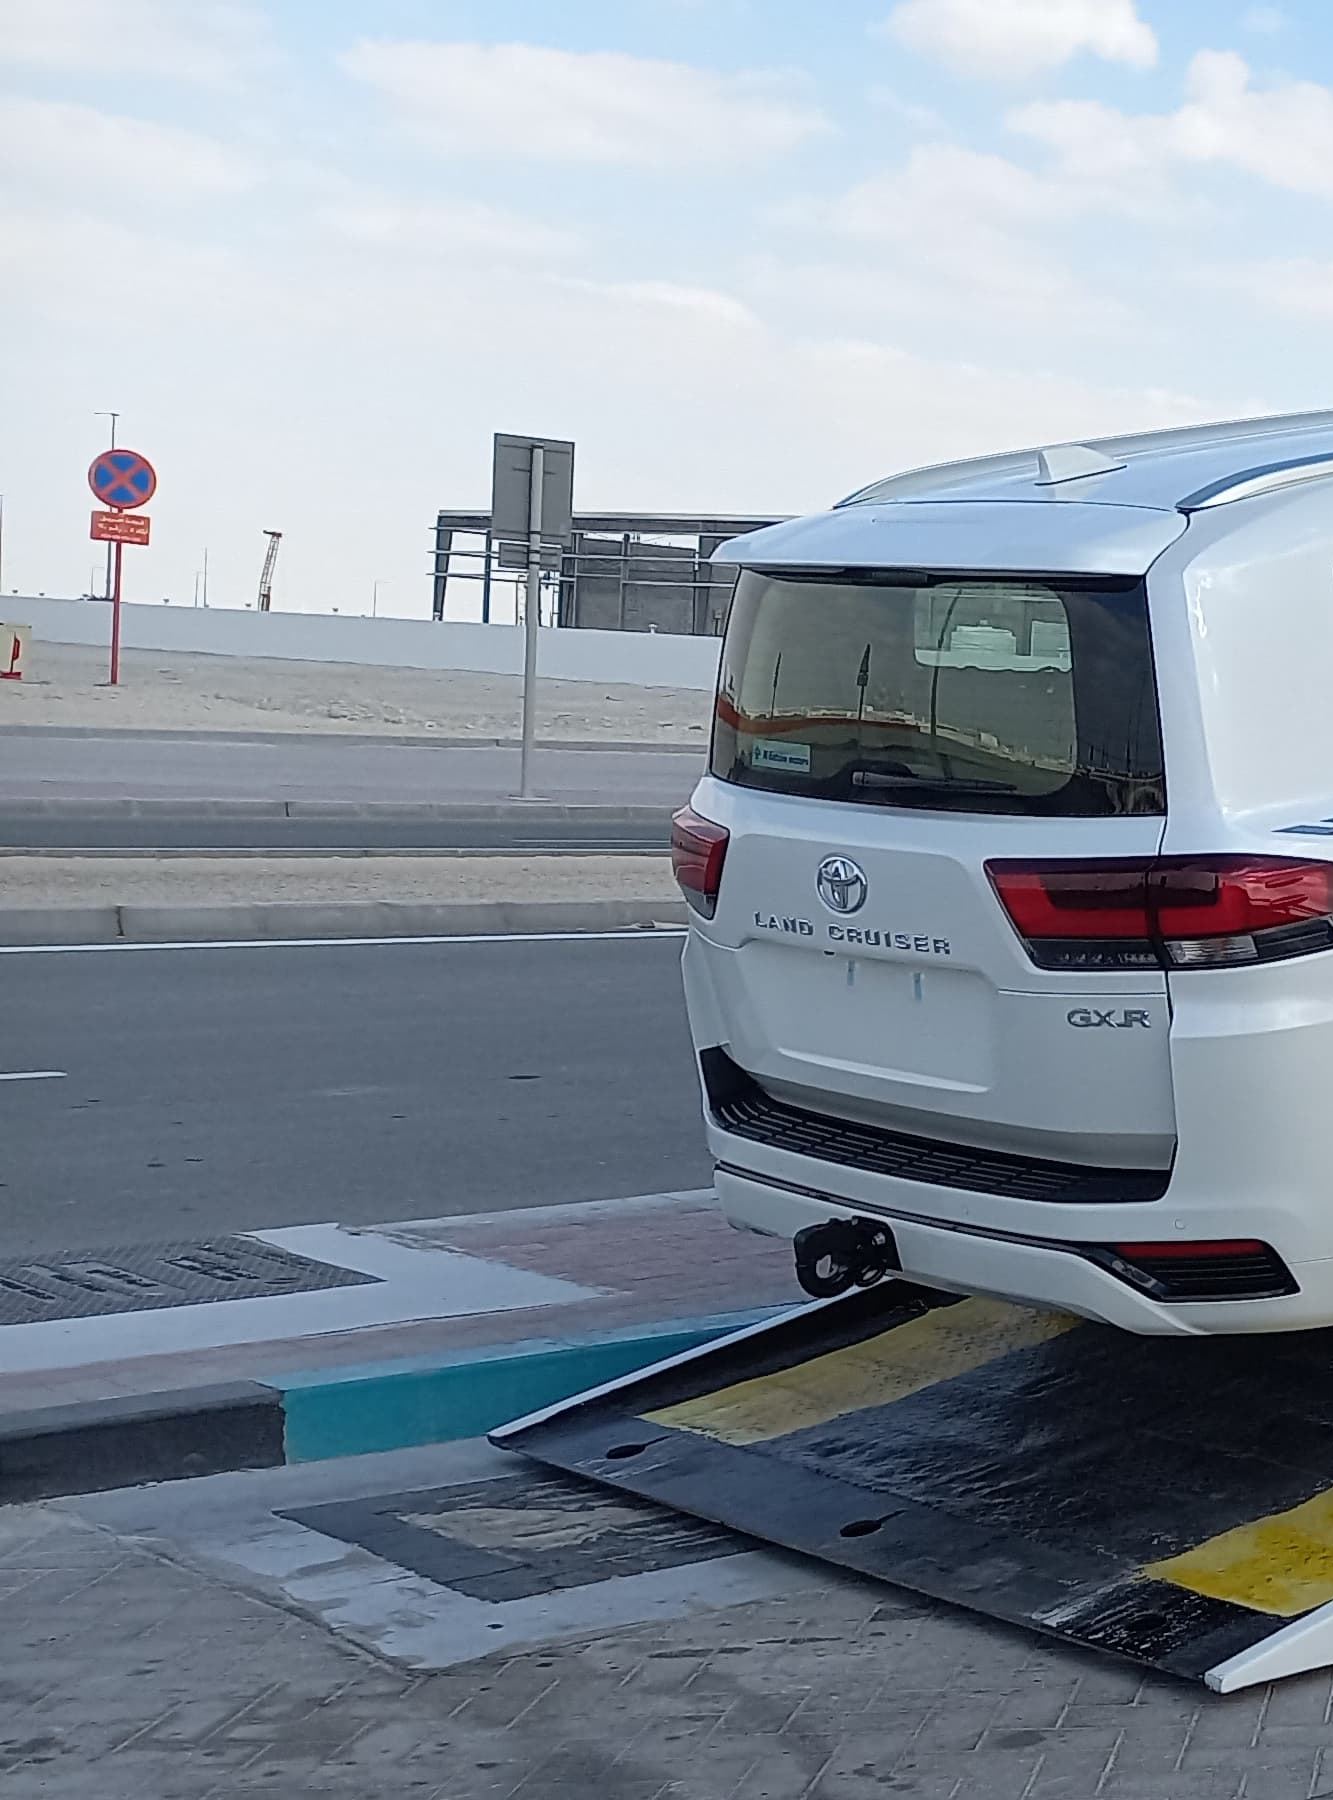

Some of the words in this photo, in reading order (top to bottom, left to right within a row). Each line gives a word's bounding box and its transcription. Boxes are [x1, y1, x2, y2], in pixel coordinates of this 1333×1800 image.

[754, 911, 814, 936] LAND
[828, 923, 951, 955] CRUISER
[1066, 1007, 1152, 1029] GXR
